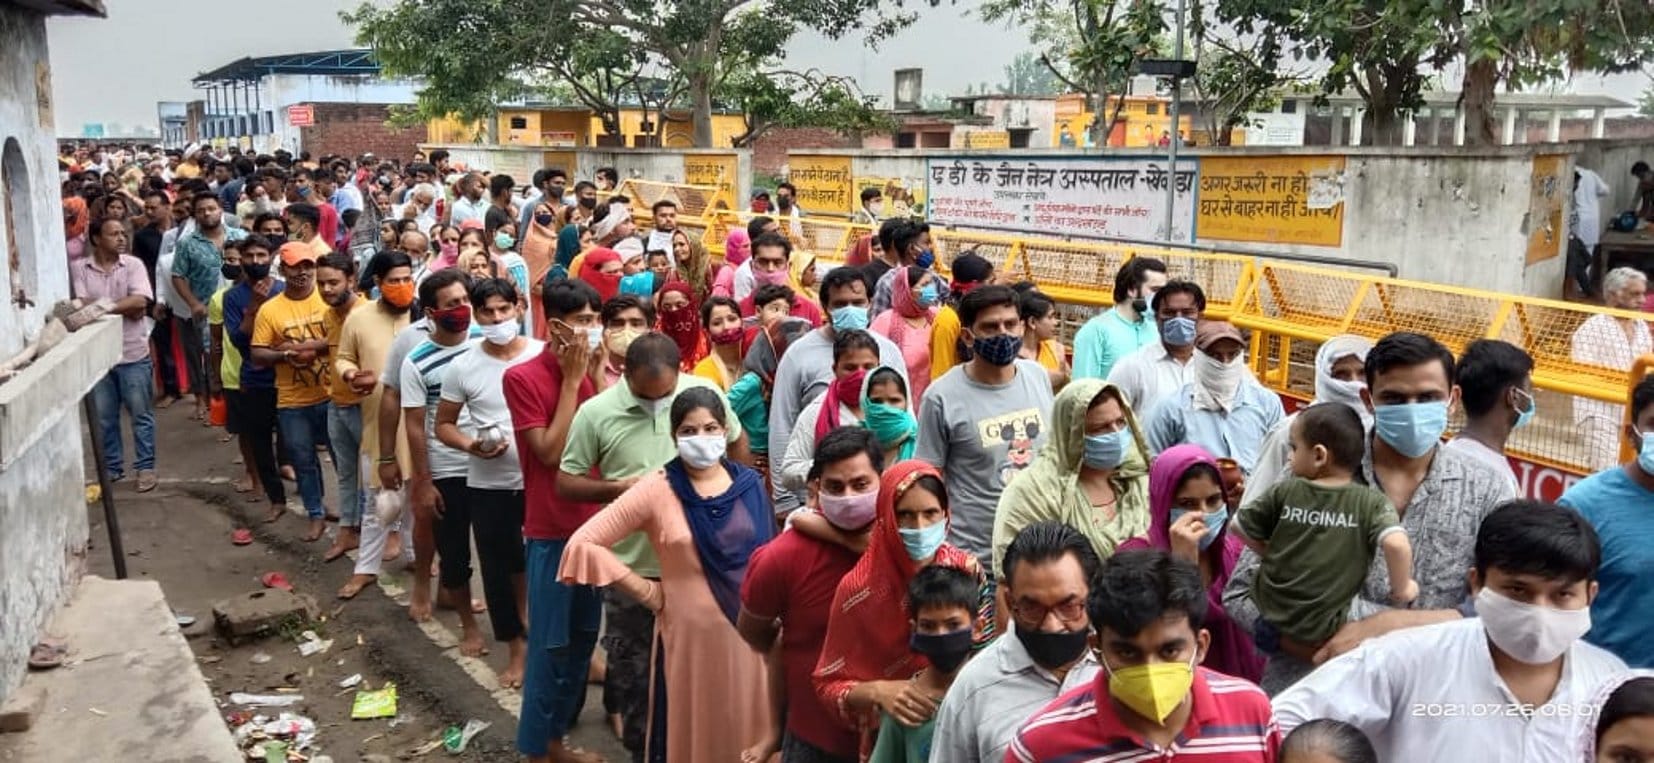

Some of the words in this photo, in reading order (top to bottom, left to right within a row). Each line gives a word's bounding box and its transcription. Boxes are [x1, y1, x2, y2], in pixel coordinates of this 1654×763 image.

[948, 160, 967, 185] डी
[973, 162, 992, 183] के
[996, 161, 1025, 187] जैन
[1027, 163, 1057, 187] नेत्र
[1060, 169, 1139, 194] अस्पताल
[1201, 175, 1230, 192] अगर
[1271, 176, 1286, 191] ना
[1201, 200, 1219, 217] घर
[1220, 195, 1232, 217] से
[1234, 201, 1263, 219] बाहर
[1280, 505, 1358, 528] ORIGINAL
